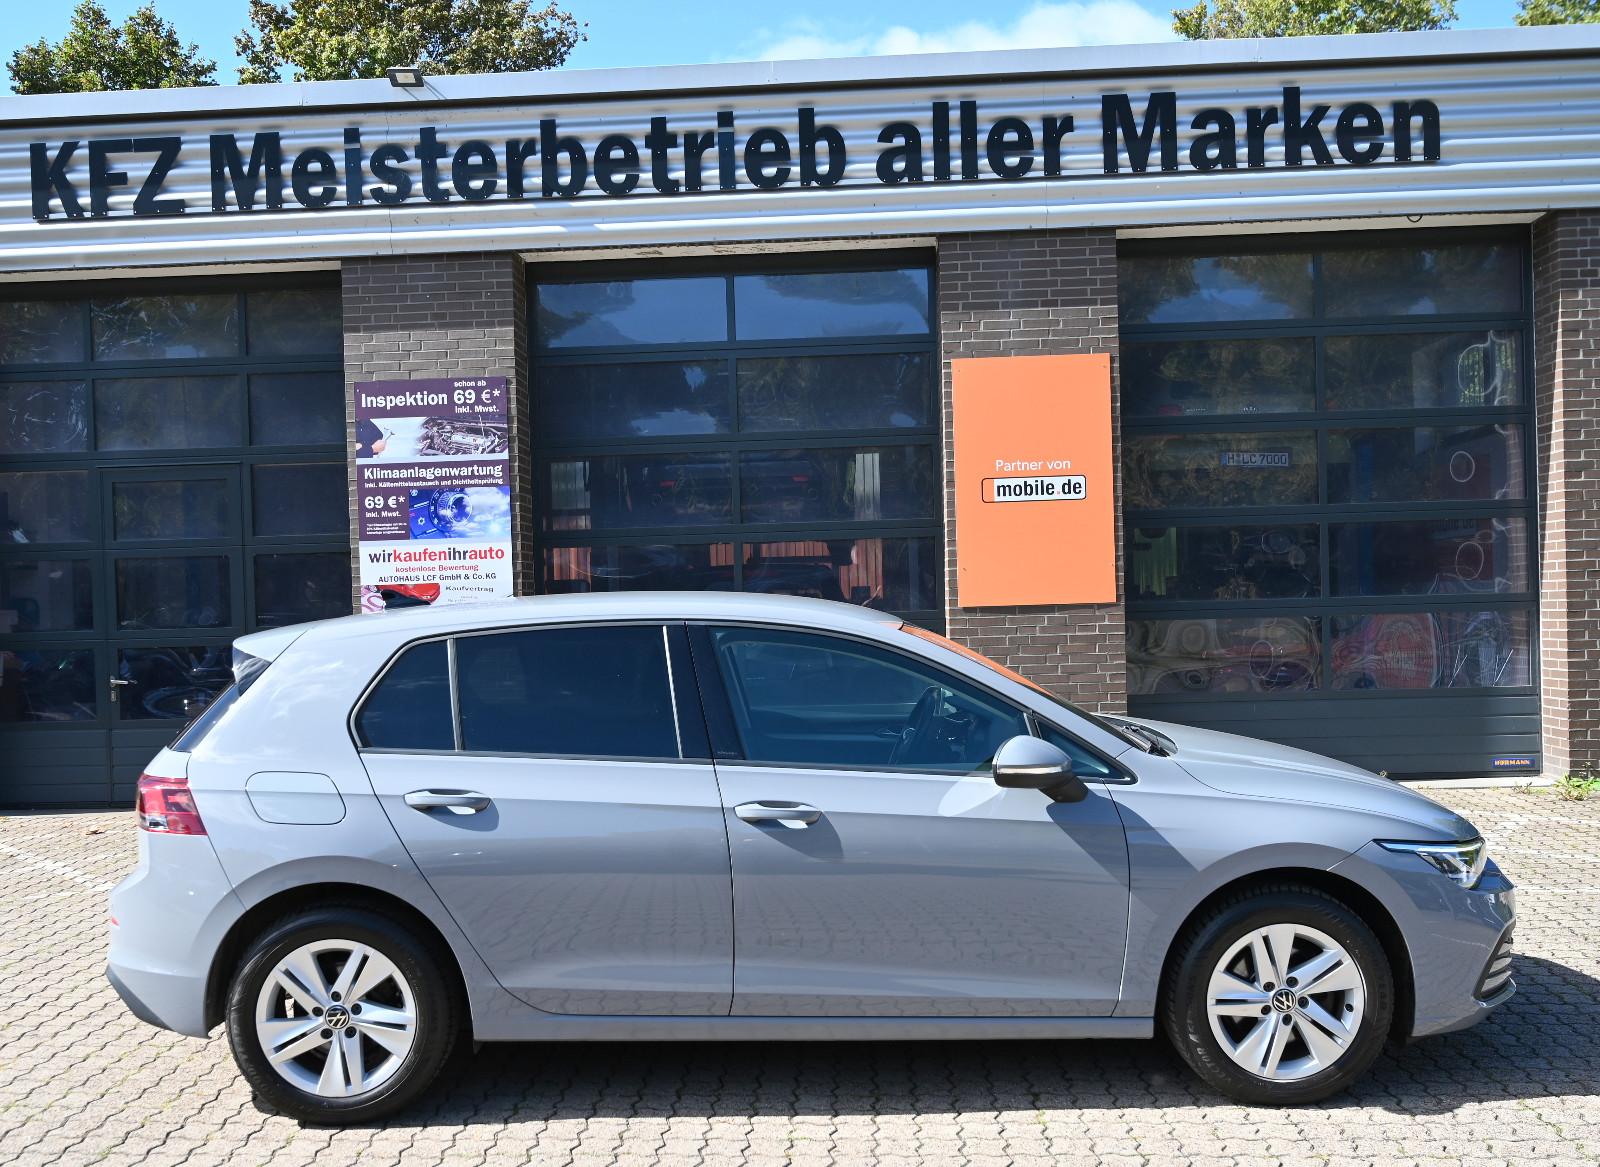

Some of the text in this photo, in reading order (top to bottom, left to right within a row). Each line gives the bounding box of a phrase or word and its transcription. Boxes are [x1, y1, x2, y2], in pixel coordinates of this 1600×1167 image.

[30, 87, 1441, 219] KFZ Meisterbetrieb aller Marken
[477, 379, 486, 387] ab
[361, 391, 448, 410] Inspektion
[454, 389, 475, 404] 69
[475, 404, 499, 413] Mwst.
[364, 464, 503, 479] Klimaanlagenwartung
[995, 459, 1071, 472] Partner von
[997, 479, 1083, 497] mobile.de
[364, 496, 384, 509] 69
[369, 546, 505, 564] wirkaufenihrauto
[395, 564, 479, 573] kostenlose Bewertung
[378, 574, 420, 583] AUTOHAUS
[422, 574, 437, 582] LCF
[439, 573, 462, 581] GmbH
[463, 573, 470, 581] &
[445, 585, 494, 593] Kaufvertrag
